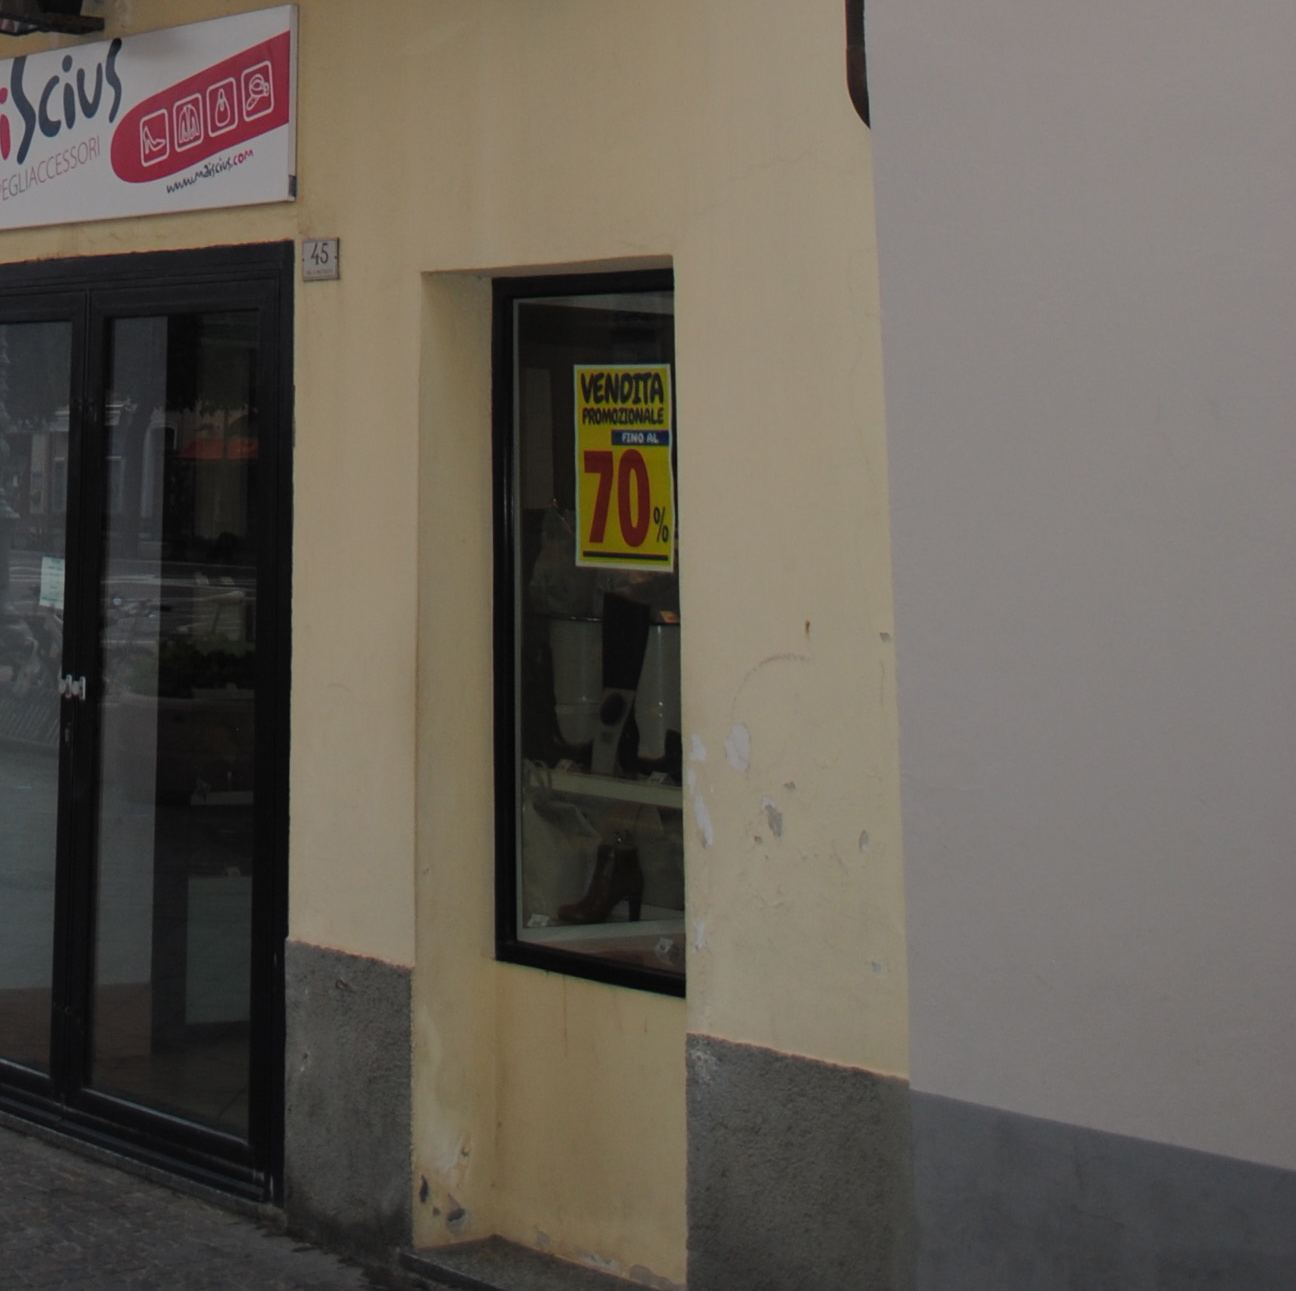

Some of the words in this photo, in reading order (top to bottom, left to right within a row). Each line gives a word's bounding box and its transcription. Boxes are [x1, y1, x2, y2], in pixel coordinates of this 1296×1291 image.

[311, 242, 329, 265] 45
[581, 372, 664, 405] VENDITA
[582, 407, 664, 426] PROMOZIONALE
[622, 432, 644, 443] FINO
[647, 432, 659, 443] AL
